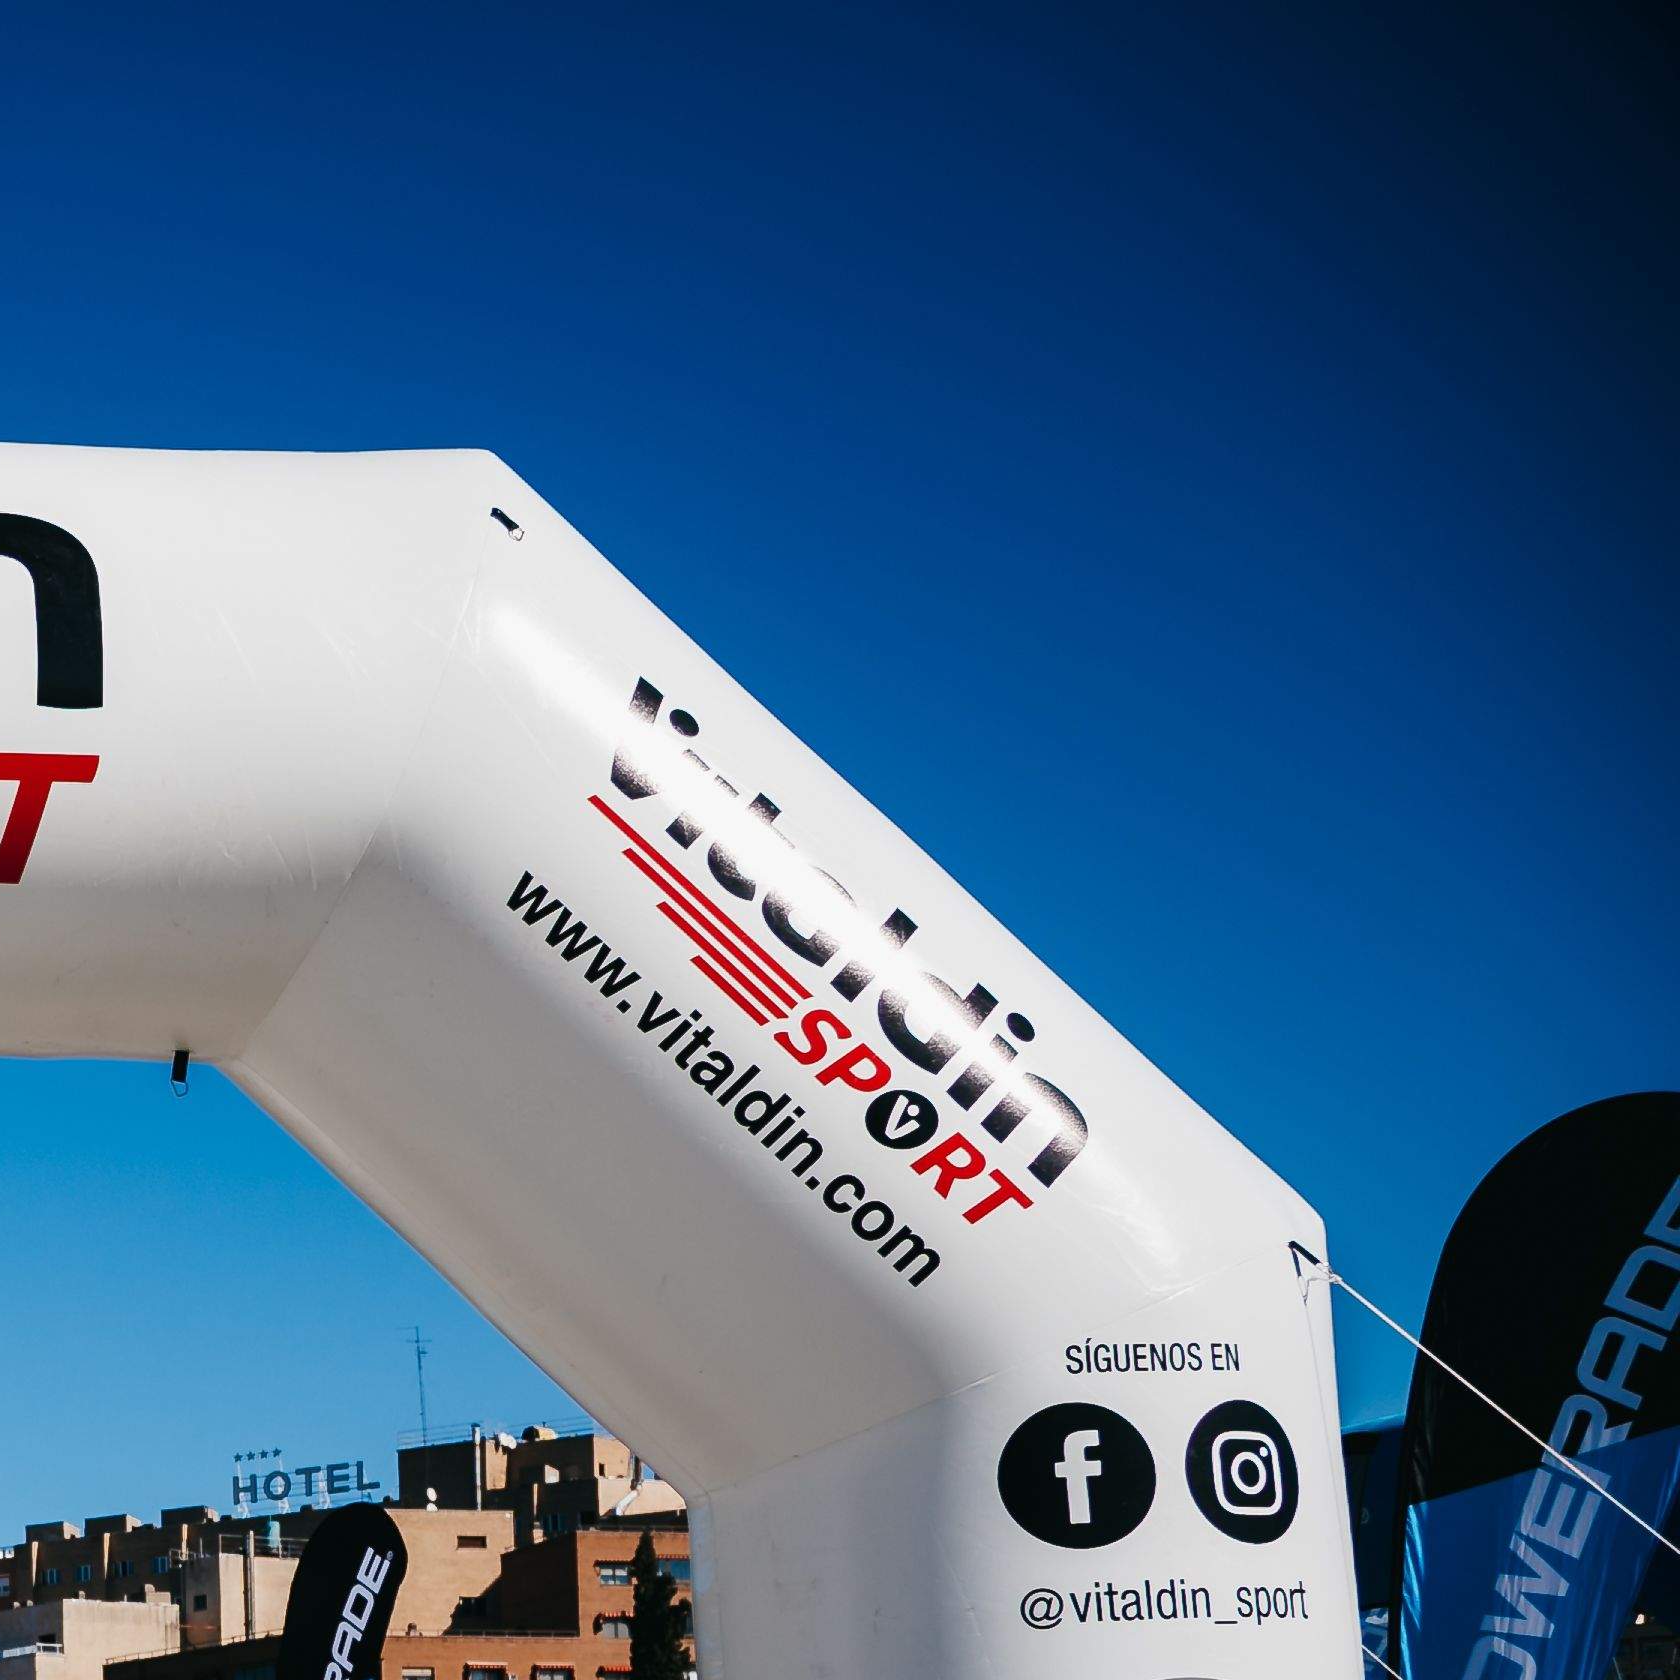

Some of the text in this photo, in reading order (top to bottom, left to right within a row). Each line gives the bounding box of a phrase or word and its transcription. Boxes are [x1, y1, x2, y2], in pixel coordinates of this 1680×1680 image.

[506, 871, 940, 1287] www.vitaldin.com
[773, 1009, 1033, 1225] SPORT
[1066, 1338, 1242, 1375] SÍGUENOS EN
[232, 1460, 381, 1506] HOTEL
[1021, 1579, 1309, 1630] @vitaldin_sport
